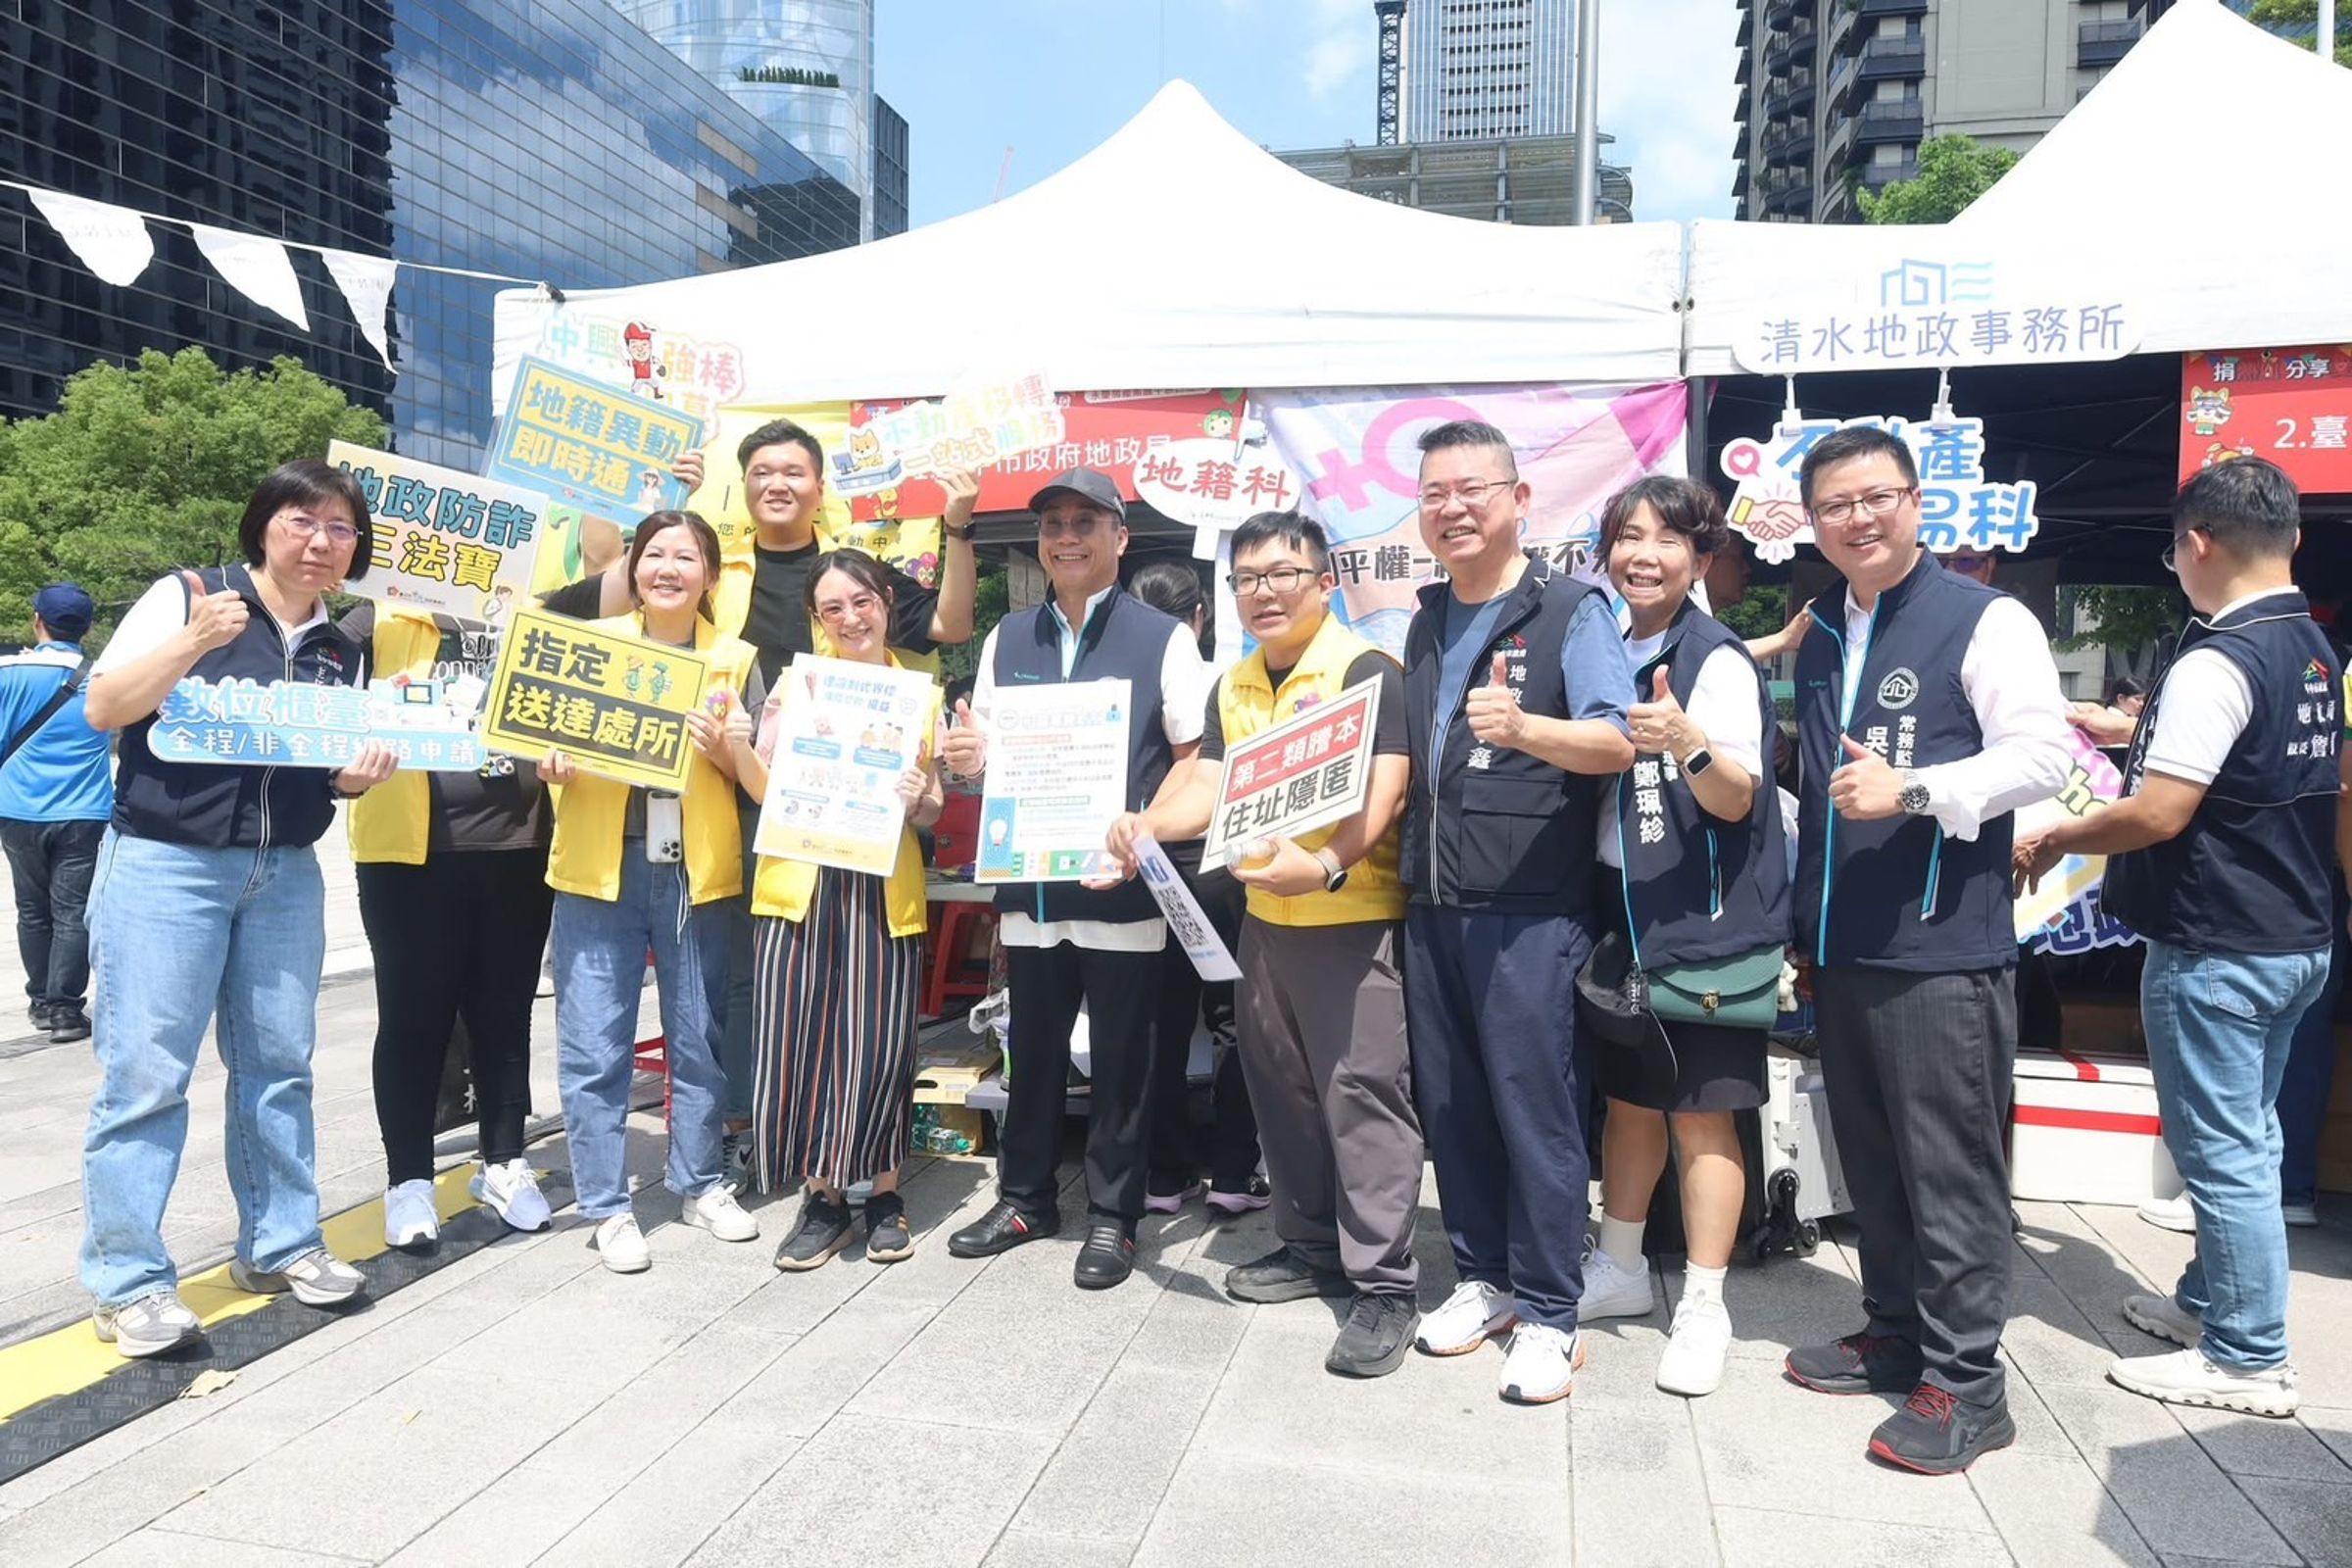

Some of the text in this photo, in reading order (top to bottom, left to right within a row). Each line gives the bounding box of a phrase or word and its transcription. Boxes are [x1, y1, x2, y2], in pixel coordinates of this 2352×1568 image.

[1760, 302, 2125, 365] 清水地政事務所
[2285, 358, 2329, 380] 分享
[527, 379, 682, 465] 地籍異動
[1775, 420, 1979, 481] 不產
[2274, 415, 2348, 449] 2.臺
[510, 424, 631, 497] 即時通
[1139, 454, 1291, 509] 地籍科
[518, 627, 612, 687] 指定
[161, 677, 371, 733] 數位櫃臺
[505, 682, 679, 760] 送達處所
[1232, 712, 1361, 792] 第二類謄本
[1223, 754, 1354, 843] 住址隱匿
